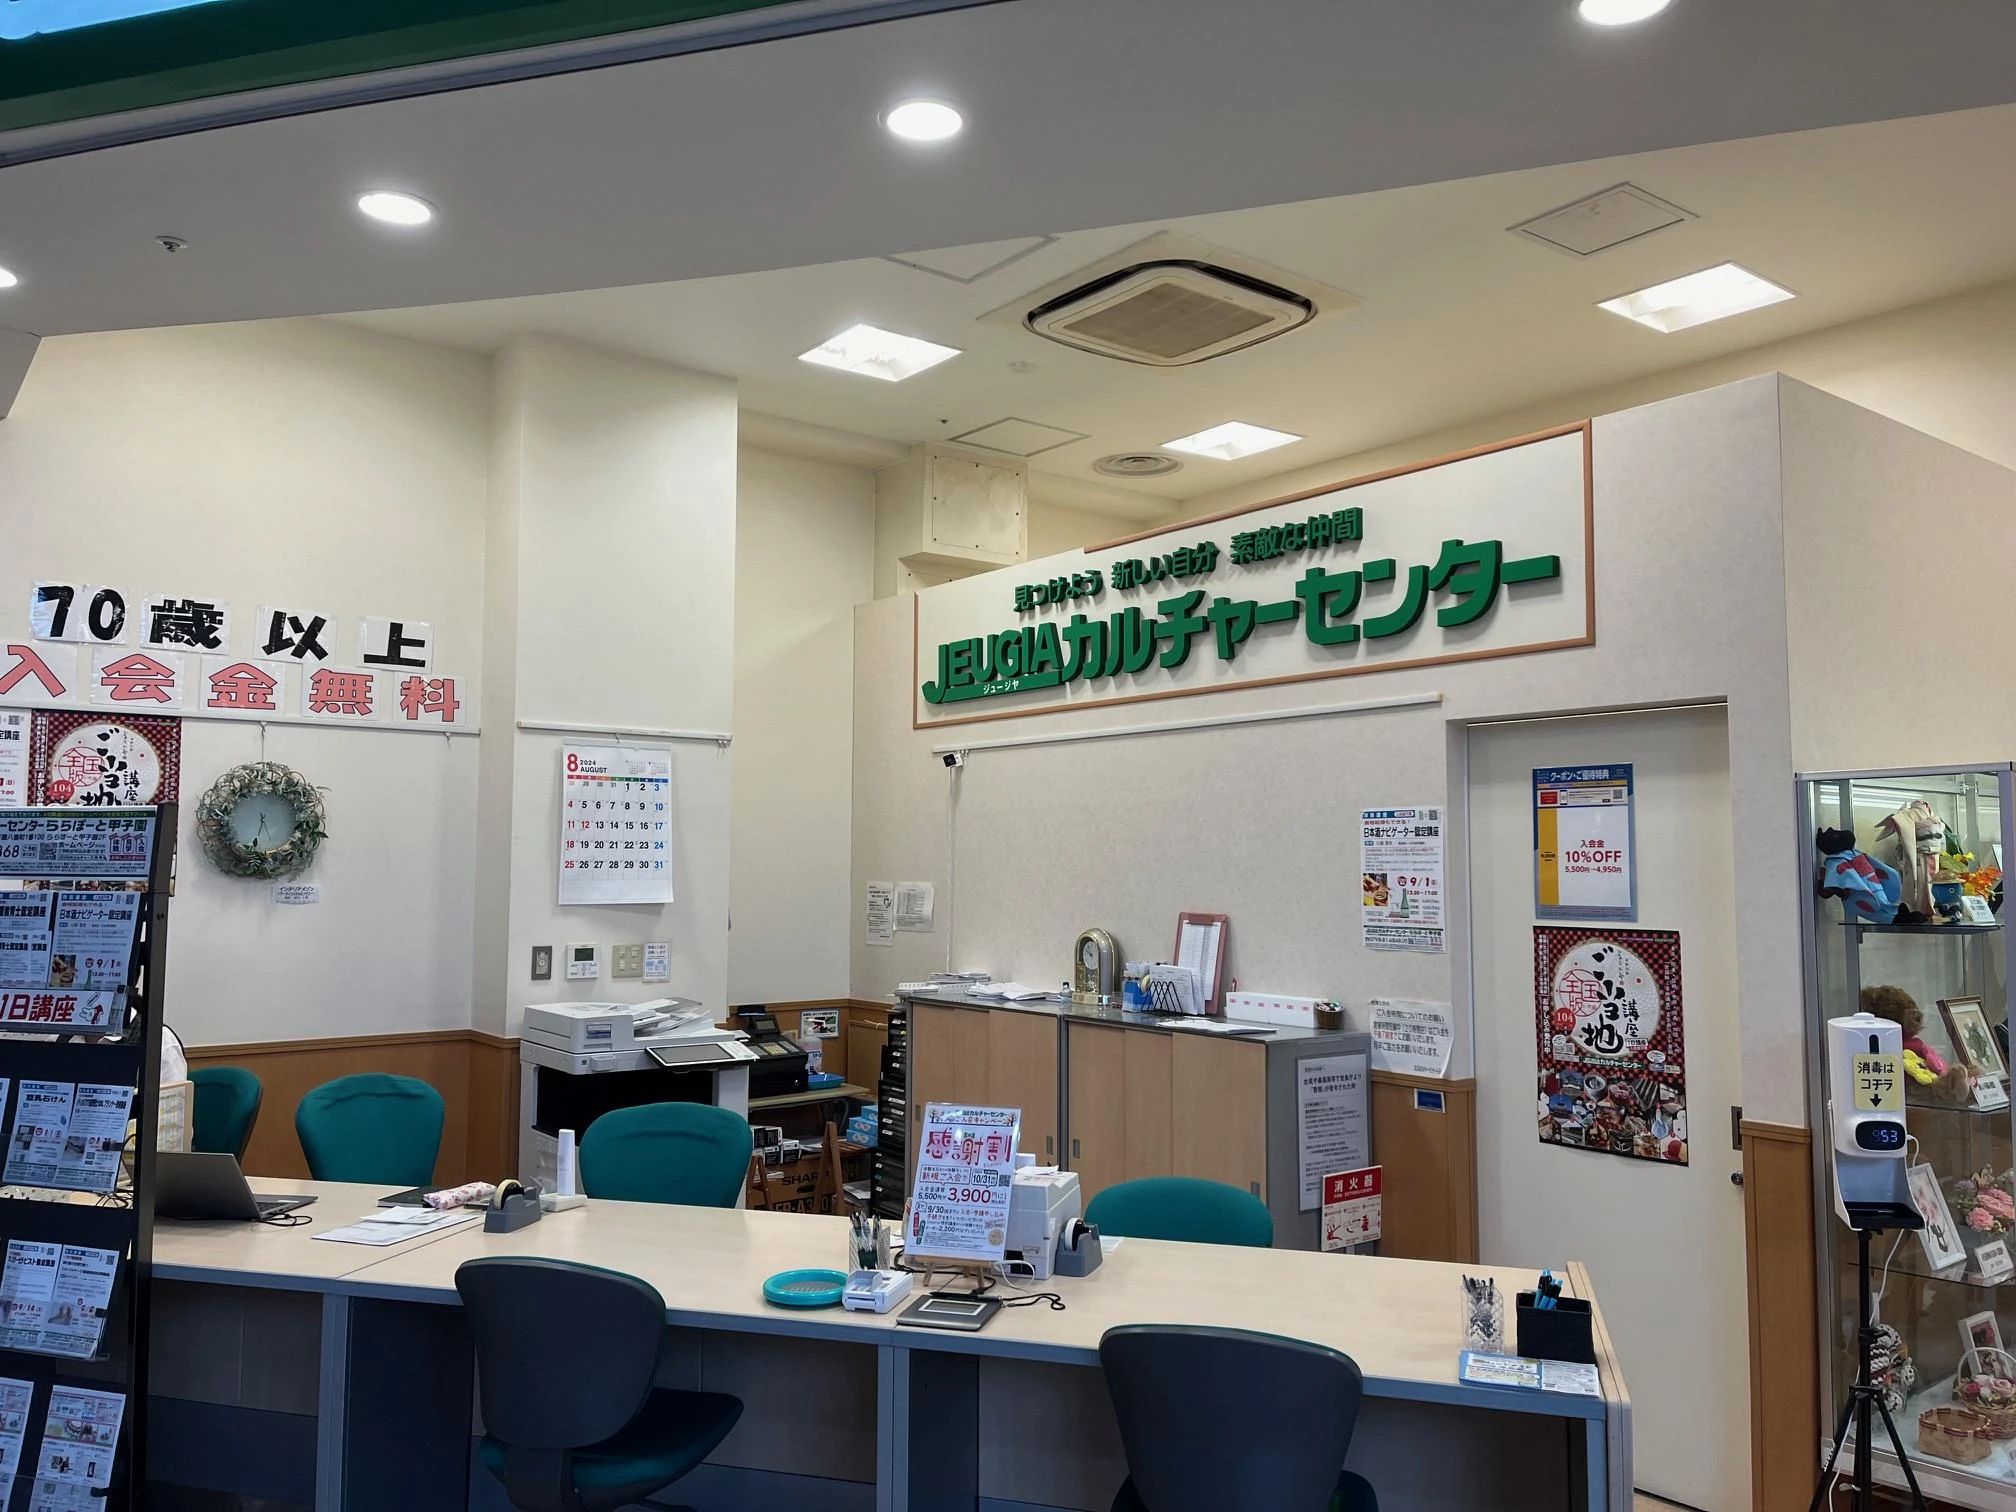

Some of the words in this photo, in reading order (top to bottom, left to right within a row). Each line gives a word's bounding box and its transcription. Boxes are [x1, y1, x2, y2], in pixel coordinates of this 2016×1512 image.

[1014, 567, 1102, 612] 見つけよう
[1111, 541, 1221, 590] 新しい自分
[1230, 507, 1364, 566] 素敵な仲間
[37, 585, 426, 668] 70歳以上
[921, 539, 1560, 704] JEUGIAカルチャーセンター
[0, 644, 460, 722] 入会金無料
[567, 754, 578, 772] 8
[654, 783, 660, 791] 3
[568, 800, 573, 808] 4
[596, 801, 601, 809] 6
[625, 802, 630, 810] 8
[640, 802, 645, 810] 9
[655, 803, 663, 811] 10
[581, 821, 590, 829] 12
[596, 821, 604, 829] 13
[625, 822, 634, 830] 15
[640, 822, 649, 830] 16
[655, 822, 663, 830] 17
[595, 841, 604, 849] 20
[609, 841, 618, 849] 21
[624, 841, 634, 849] 22
[639, 841, 649, 849] 23
[1580, 839, 1605, 848] 入会金
[1565, 850, 1622, 863] 10%OFF
[654, 861, 663, 869] 31
[1858, 1061, 1894, 1074] 消毒は
[1861, 1078, 1893, 1091] コチラ
[1334, 1174, 1373, 1193] 消火器
